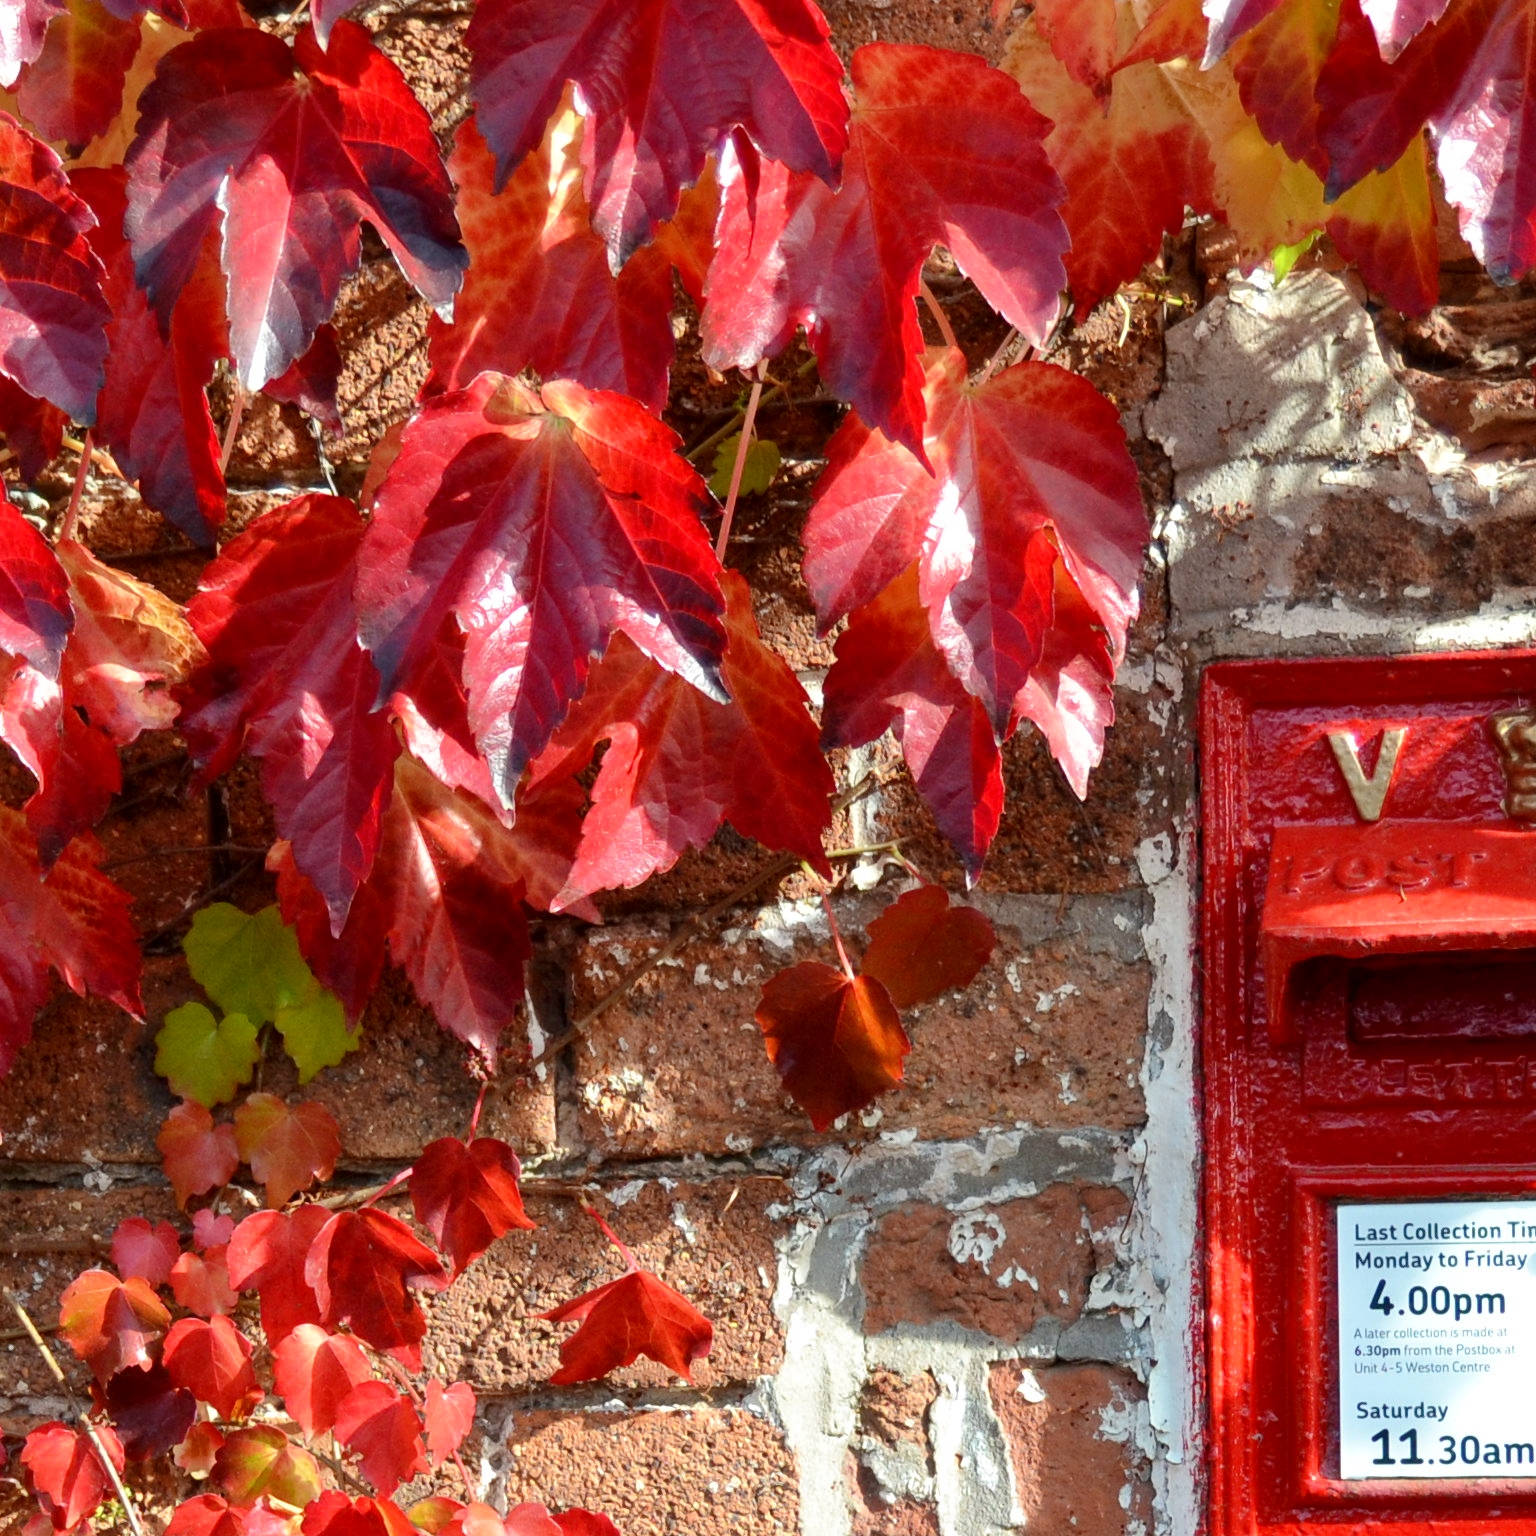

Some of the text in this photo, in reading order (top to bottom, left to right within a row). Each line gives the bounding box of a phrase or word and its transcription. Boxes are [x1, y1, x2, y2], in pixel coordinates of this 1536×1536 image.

[1328, 727, 1408, 822] V
[1283, 849, 1487, 894] POST
[1355, 1223, 1397, 1241] Last
[1403, 1221, 1501, 1240] Collection
[1355, 1250, 1527, 1271] Monday to Friday
[1369, 1279, 1506, 1321] 4.00pm
[1353, 1327, 1507, 1339] A later collection is made at
[1354, 1344, 1515, 1359] 6.30pm from the Postbox at
[1354, 1361, 1490, 1374] Unit 4-5 Weston Centre
[1357, 1402, 1448, 1422] Saturday
[1371, 1428, 1535, 1465] 11.30am
